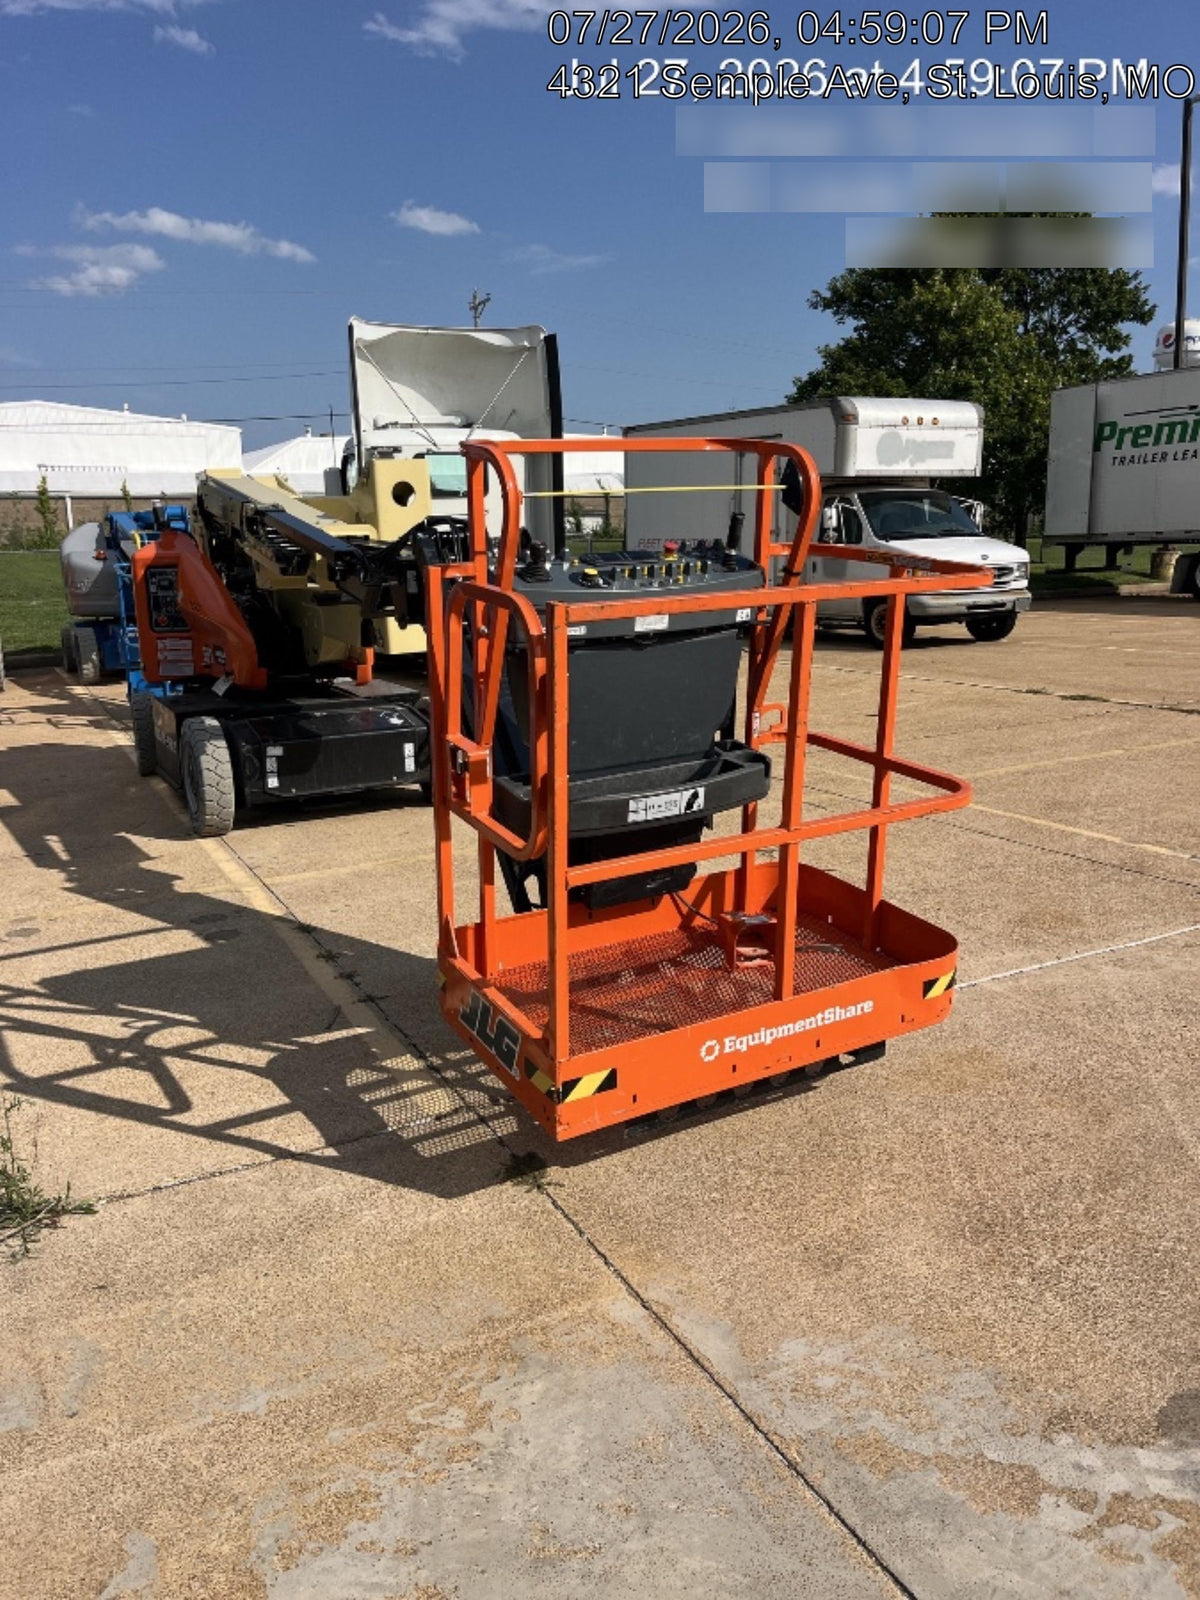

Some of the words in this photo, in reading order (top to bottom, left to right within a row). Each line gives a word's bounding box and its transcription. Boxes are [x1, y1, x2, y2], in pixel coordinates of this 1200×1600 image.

[1111, 451, 1169, 466] TRAILER
[458, 987, 521, 1073] JLG
[723, 1000, 874, 1053] EquipmentShare
